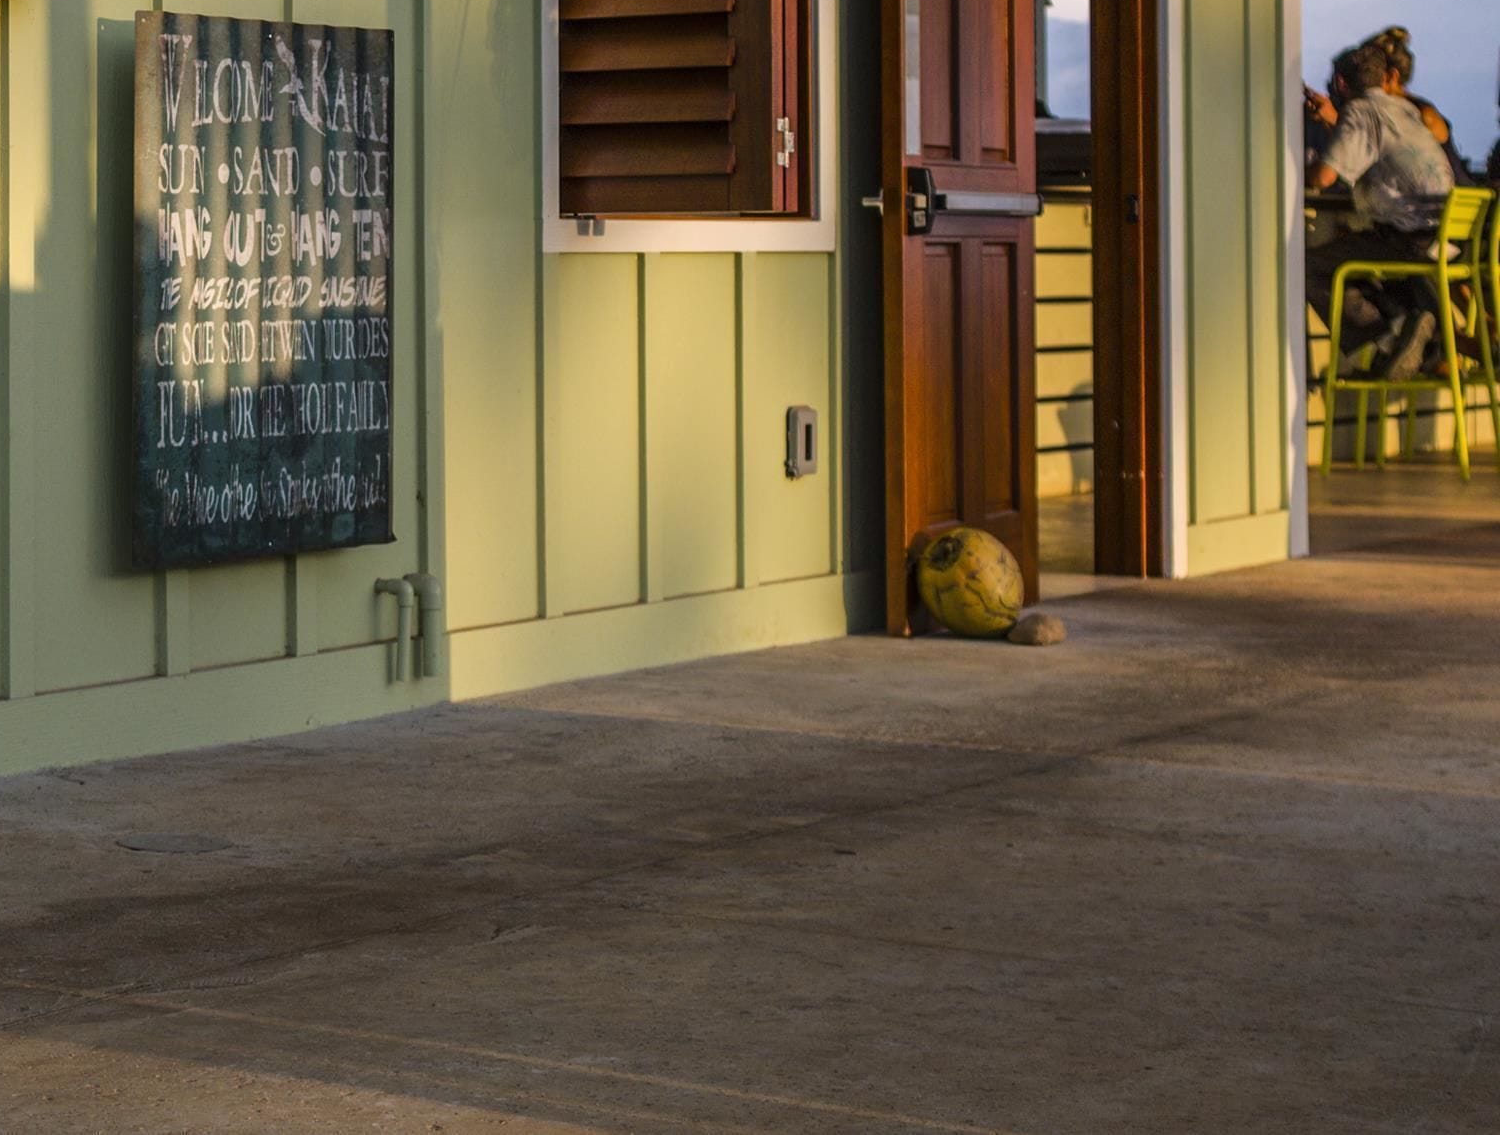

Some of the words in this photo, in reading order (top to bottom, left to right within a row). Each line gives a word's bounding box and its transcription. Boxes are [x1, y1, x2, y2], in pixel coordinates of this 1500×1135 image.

[158, 142, 206, 196] SUN
[233, 145, 300, 197] SAND
[328, 149, 389, 197] SURF
[158, 201, 213, 267] HANG
[223, 209, 266, 267] OUT
[266, 223, 286, 256] &
[290, 203, 342, 267] HANG
[352, 207, 390, 262] TEN
[181, 321, 215, 366] SOE
